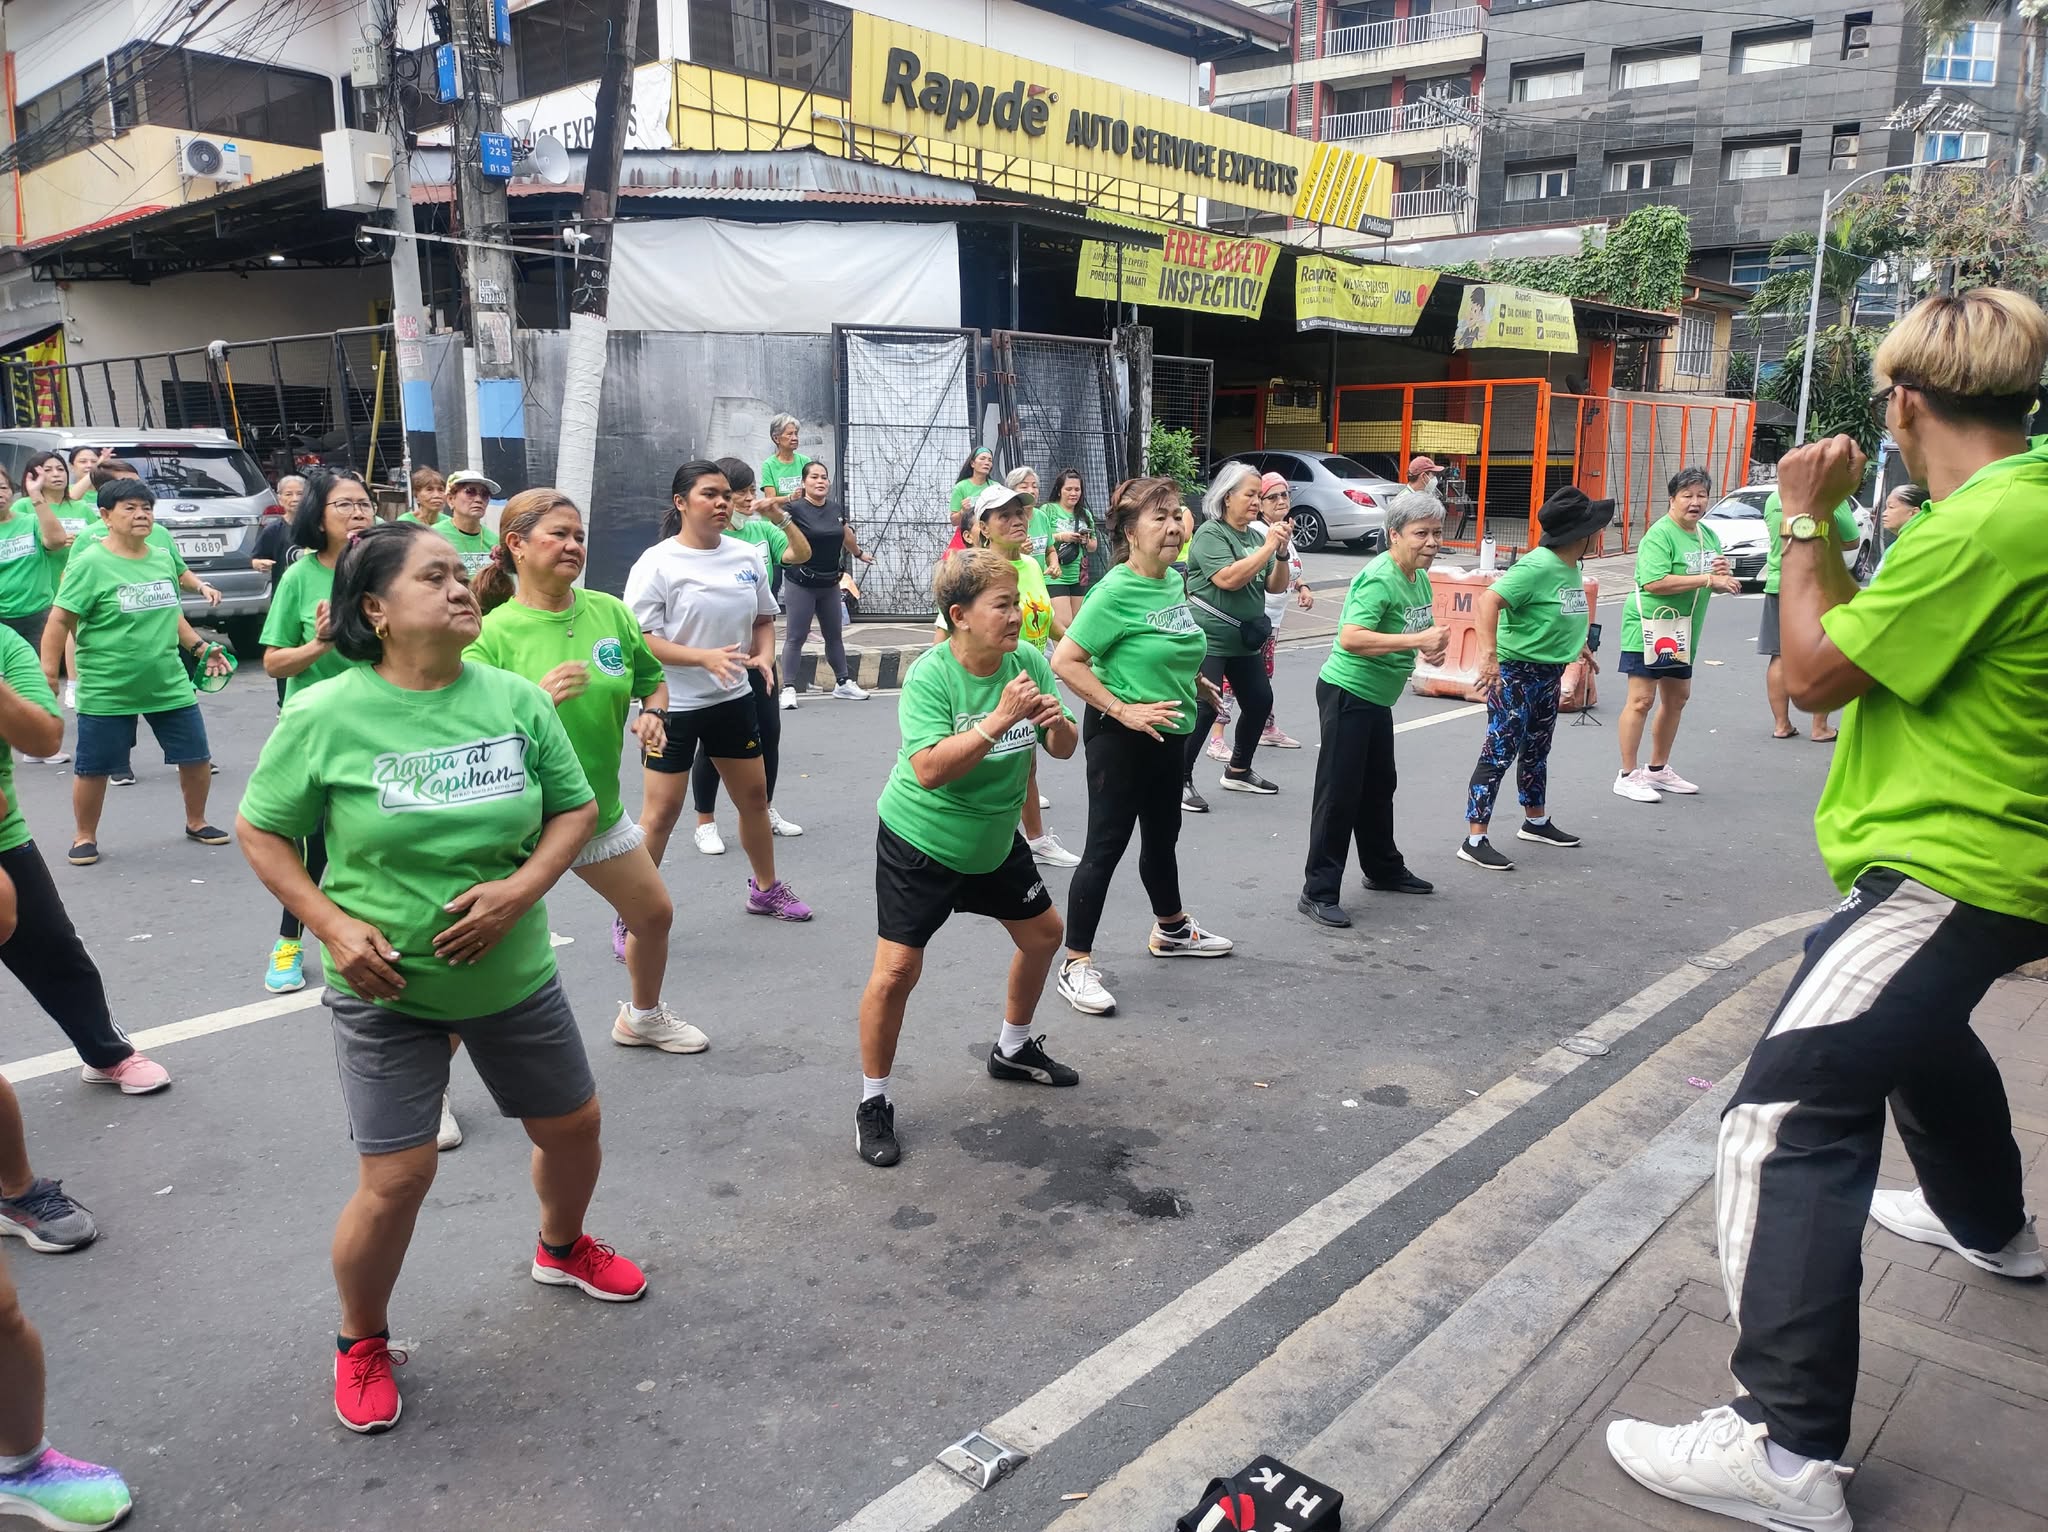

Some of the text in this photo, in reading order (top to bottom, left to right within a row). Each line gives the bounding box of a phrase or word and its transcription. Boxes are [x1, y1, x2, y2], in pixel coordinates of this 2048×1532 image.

[563, 103, 637, 149] EXPS
[488, 137, 505, 148] MKT
[489, 147, 508, 157] 225
[1066, 108, 1129, 155] AUTO
[1131, 124, 1218, 178] SERVICE
[1217, 147, 1299, 196] EXPERTS
[1302, 170, 1318, 209] BRAKES
[1340, 175, 1358, 223] MAINTENANCE
[1327, 197, 1337, 217] TIRES
[1352, 183, 1369, 225] SUSPENSION
[1163, 228, 1272, 276] FREE SAFETY
[1127, 257, 1149, 269] EXPERTS
[591, 269, 602, 279] 69
[1125, 276, 1147, 287] MAKATI
[1394, 289, 1412, 305] VISA
[1505, 326, 1524, 336] BRAKES
[194, 541, 221, 553] 6889
[1453, 591, 1473, 612] M
[1643, 629, 1654, 646] FUJI
[1675, 630, 1686, 652] JAPAN
[378, 741, 492, 784] Zumba at
[410, 766, 513, 803] Kapihan
[1728, 1460, 1783, 1511] ZUMBA
